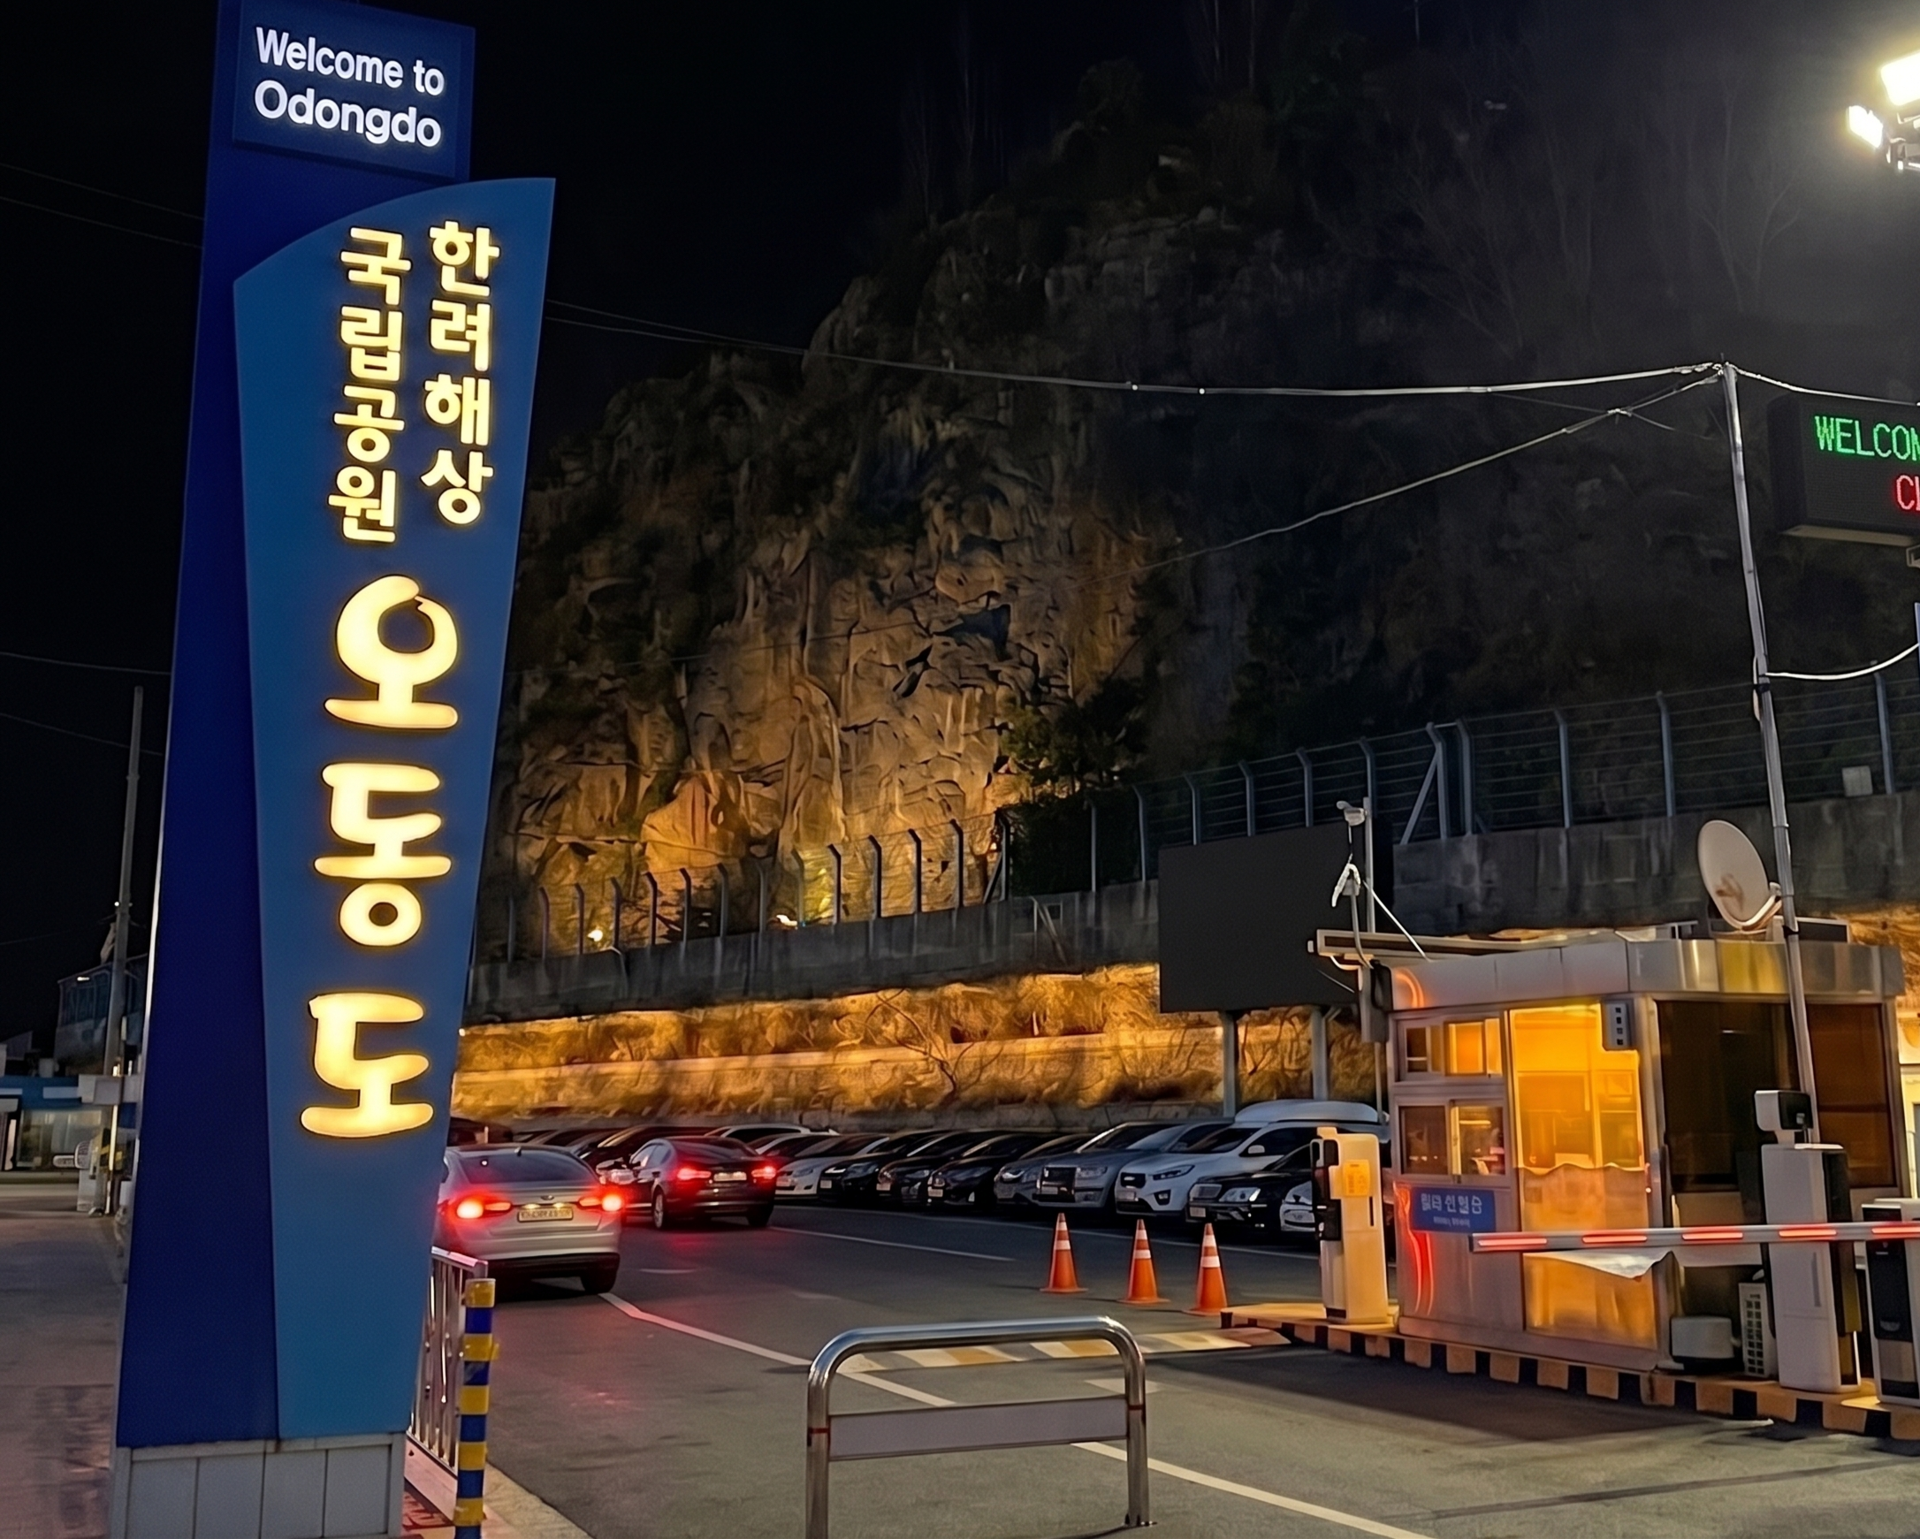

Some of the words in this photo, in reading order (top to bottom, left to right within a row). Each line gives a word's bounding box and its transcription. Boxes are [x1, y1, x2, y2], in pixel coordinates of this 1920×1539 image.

[254, 80, 442, 147] Odongdo
[256, 27, 403, 88] Welcome
[413, 60, 444, 96] to
[328, 227, 411, 543] 국립공원
[421, 221, 500, 525] 한려해상
[301, 574, 458, 1137] 오동도
